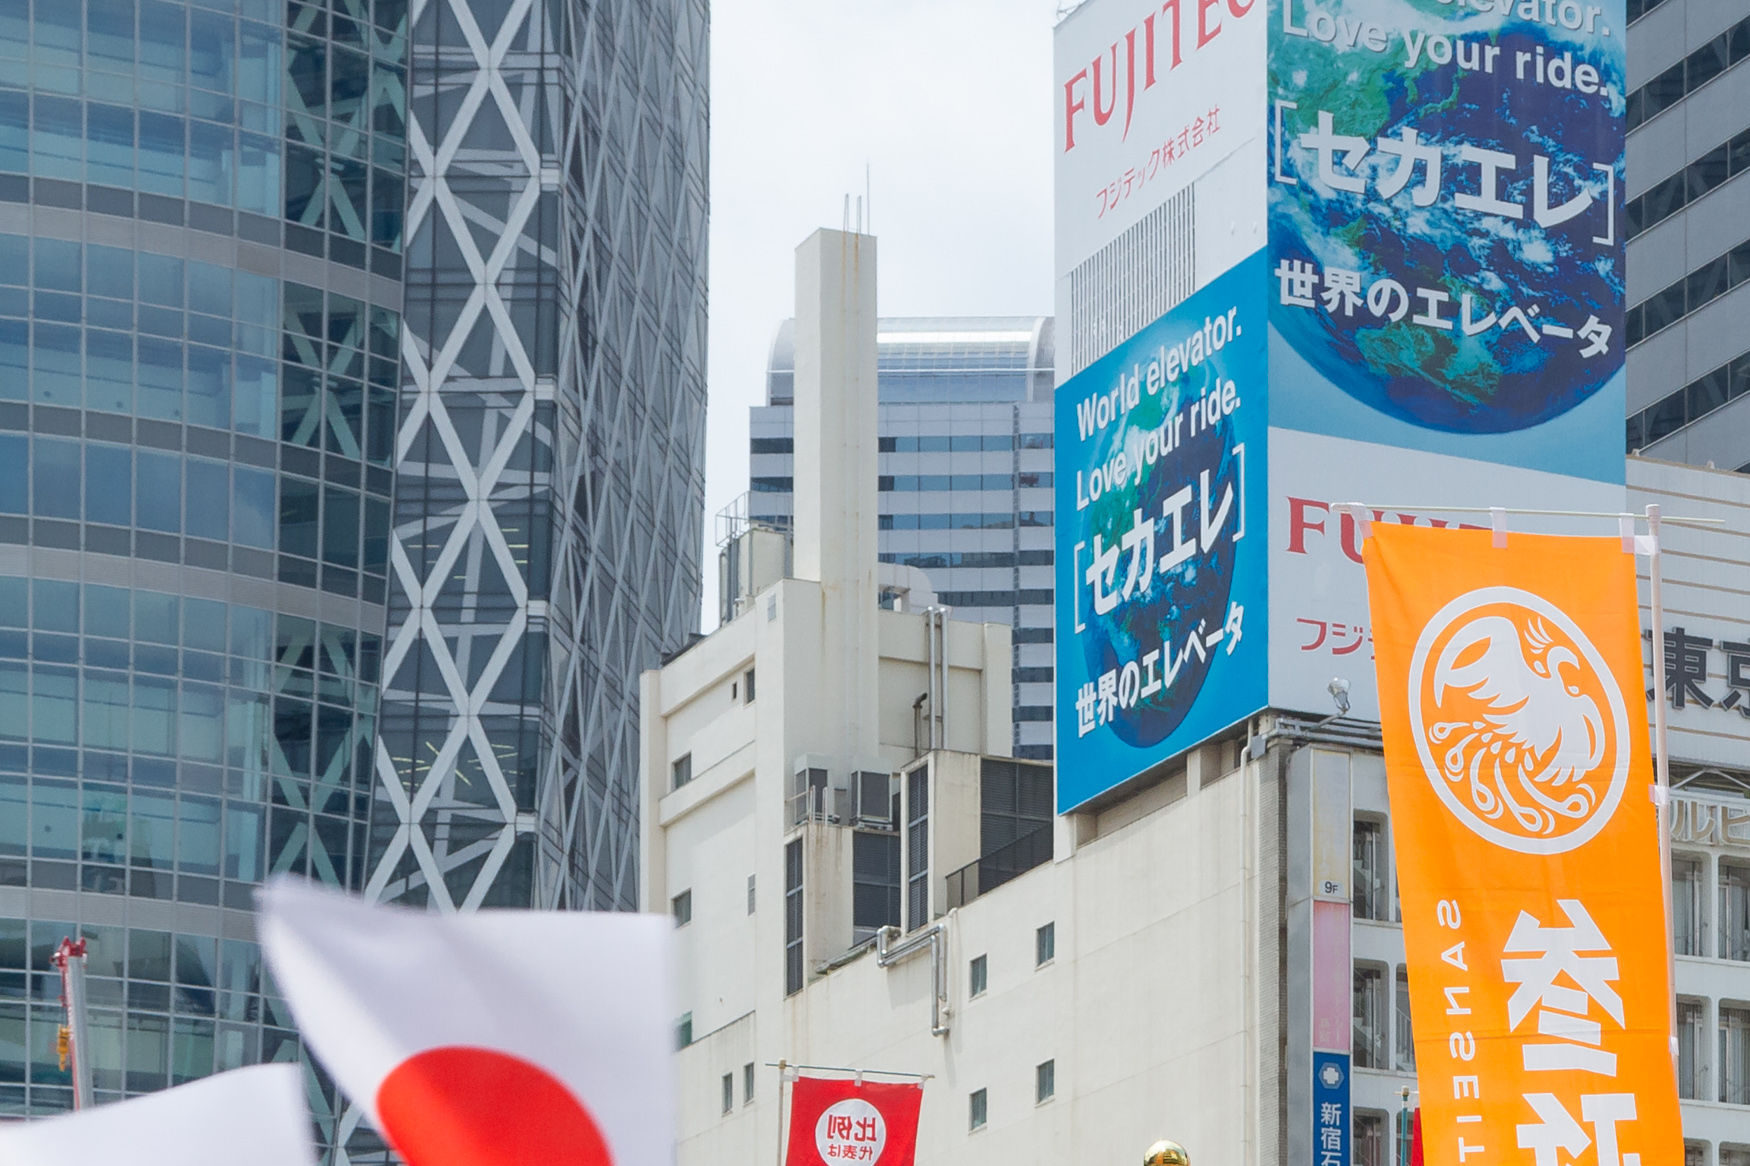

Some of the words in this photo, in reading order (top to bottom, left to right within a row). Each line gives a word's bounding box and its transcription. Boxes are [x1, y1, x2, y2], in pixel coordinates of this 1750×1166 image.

[1064, 0, 1252, 154] FUJITE
[1283, 0, 1388, 53] Love
[1403, 27, 1500, 74] your
[1516, 45, 1609, 97] ride.
[1096, 103, 1221, 220] フジテック株式会社
[1274, 258, 1613, 359] 世界のエレベータ
[1077, 363, 1140, 442] World
[1146, 306, 1242, 396] elevator.
[1076, 452, 1127, 511] Love
[1134, 413, 1184, 486] your
[1190, 378, 1241, 437] ride.
[1075, 601, 1244, 739] 世界のエレベータ
[1324, 880, 1339, 895] 9F
